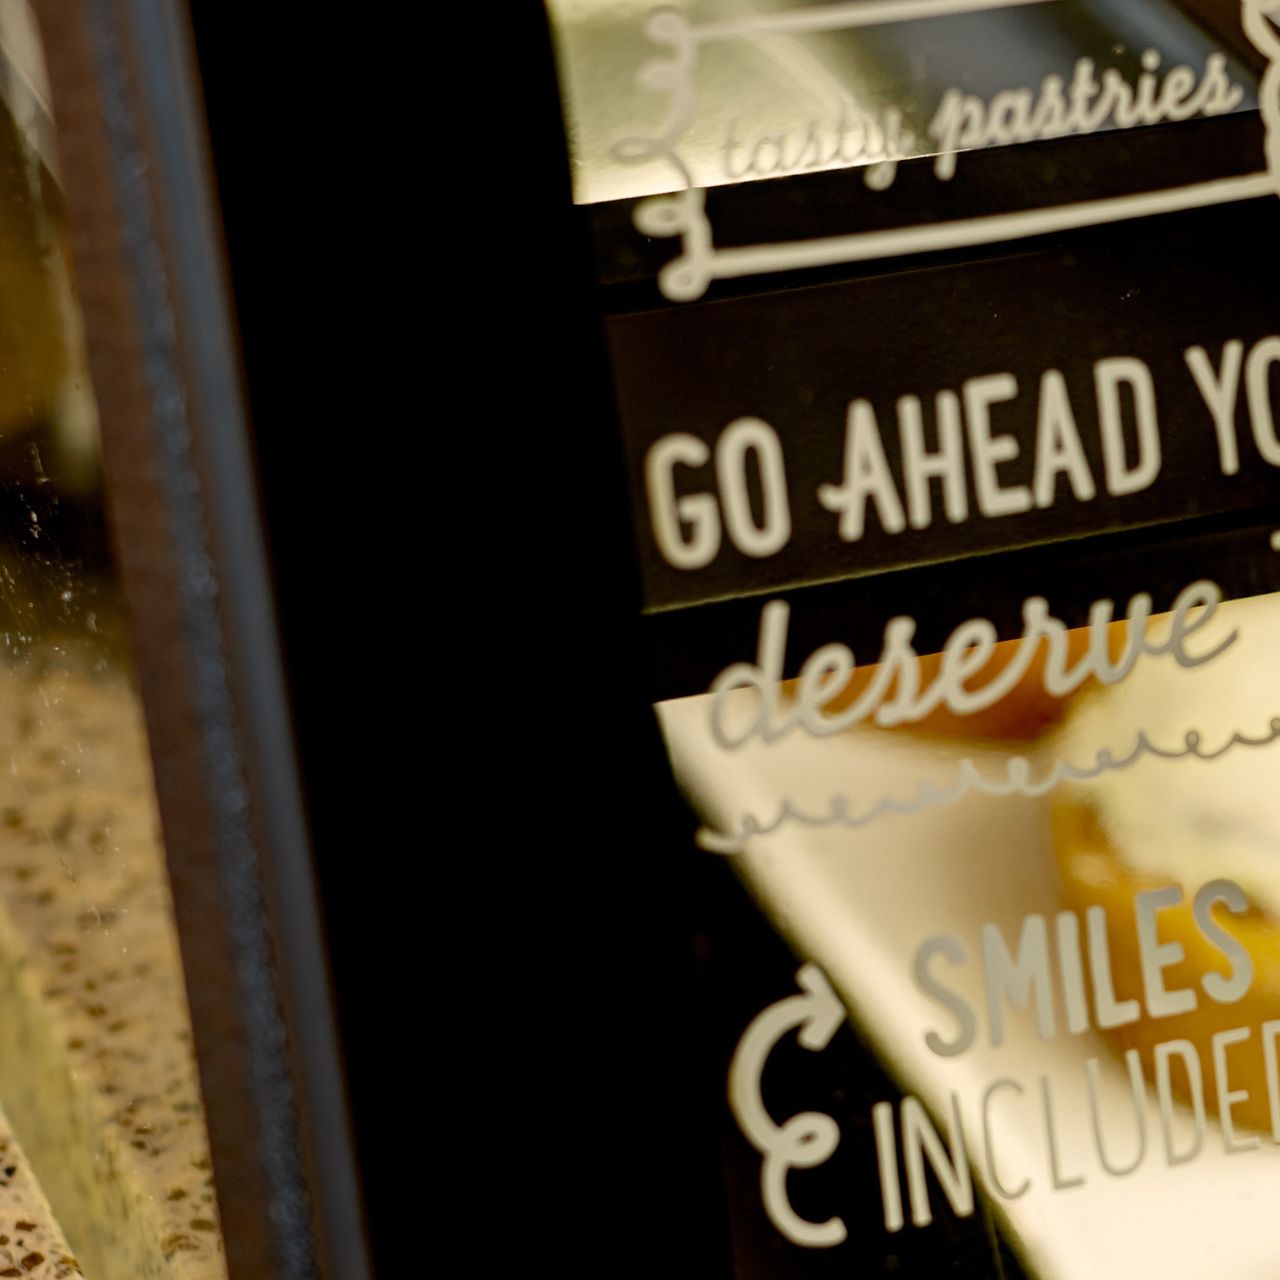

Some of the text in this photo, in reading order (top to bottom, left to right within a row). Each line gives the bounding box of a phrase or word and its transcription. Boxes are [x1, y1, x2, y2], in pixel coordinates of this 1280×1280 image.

[722, 50, 1244, 192] tasty pastries
[644, 416, 792, 571] GO
[818, 356, 1162, 542] AHEAD
[706, 579, 1239, 752] deserve
[913, 878, 1255, 1058] SMILES
